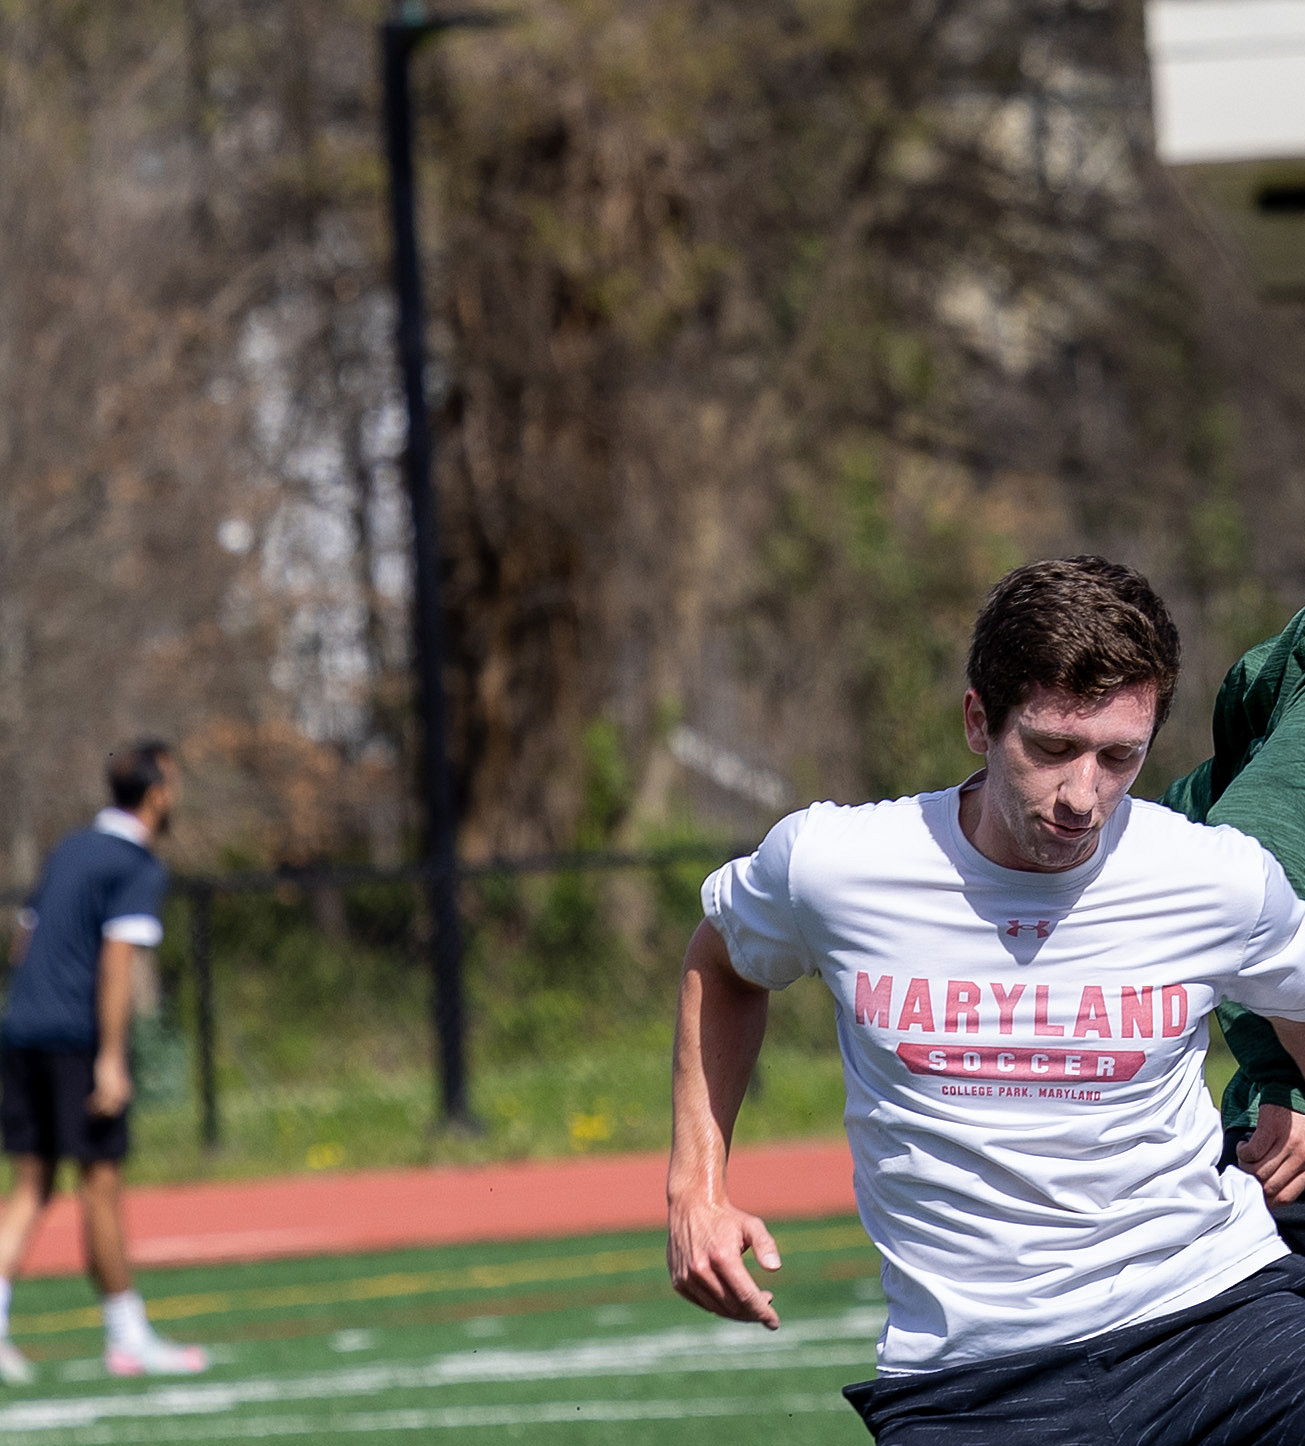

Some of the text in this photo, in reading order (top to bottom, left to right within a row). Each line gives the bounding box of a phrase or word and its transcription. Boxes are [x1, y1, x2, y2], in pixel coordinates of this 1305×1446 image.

[855, 970, 1188, 1039] MARYLAND
[928, 1048, 1115, 1078] SOCCER
[941, 1085, 993, 1097] COLLEGE
[1039, 1087, 1103, 1101] MARYLAND
